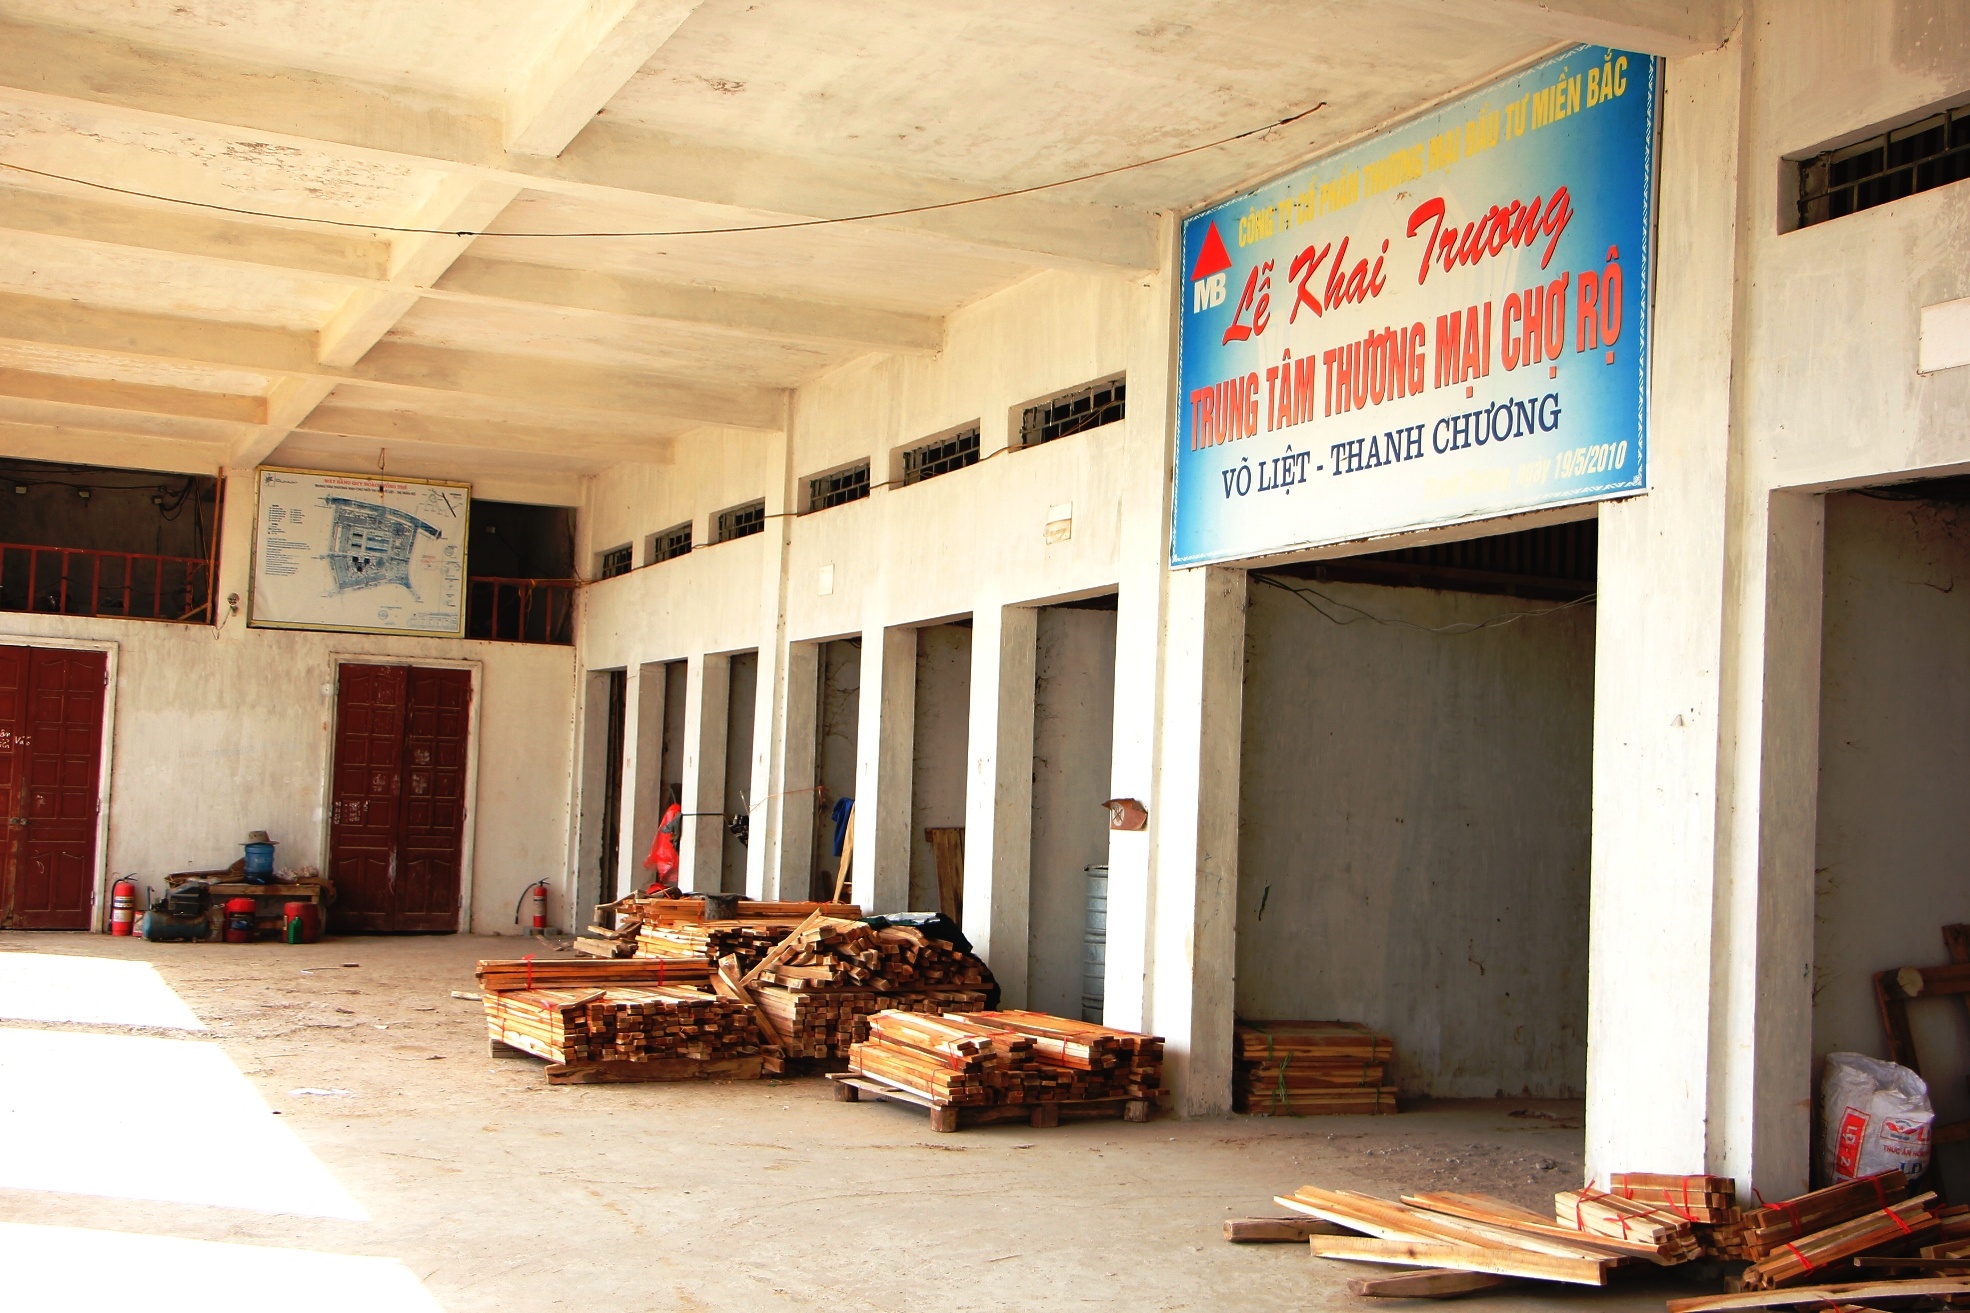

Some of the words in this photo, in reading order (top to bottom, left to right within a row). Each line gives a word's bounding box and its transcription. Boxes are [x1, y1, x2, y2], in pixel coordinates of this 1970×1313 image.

[1238, 205, 1275, 247] CÔNG
[1278, 198, 1295, 232] TY
[1320, 162, 1359, 217] PHẦN
[1428, 126, 1462, 174] MẠI
[1506, 93, 1531, 142] TƯ
[1532, 66, 1582, 131] MIỀN
[1586, 50, 1628, 108] BẮC
[1193, 272, 1226, 315] MB
[1222, 258, 1275, 346] Lễ
[1288, 235, 1390, 325] Khai
[1406, 185, 1574, 285] Trương
[1190, 371, 1260, 452] TRUNG
[1266, 347, 1316, 432] TÂM
[1323, 321, 1426, 418] THƯƠNG
[1434, 301, 1492, 399] MẠI
[1501, 271, 1569, 379] CHỢ
[1576, 245, 1623, 365] RỘ
[1221, 456, 1252, 499] VÕ
[1258, 443, 1311, 496] LIỆT
[1316, 464, 1324, 472] -
[1330, 413, 1426, 477] THANH
[1433, 392, 1562, 455] CHƯƠNG
[1554, 440, 1627, 480] 19/5/2010
